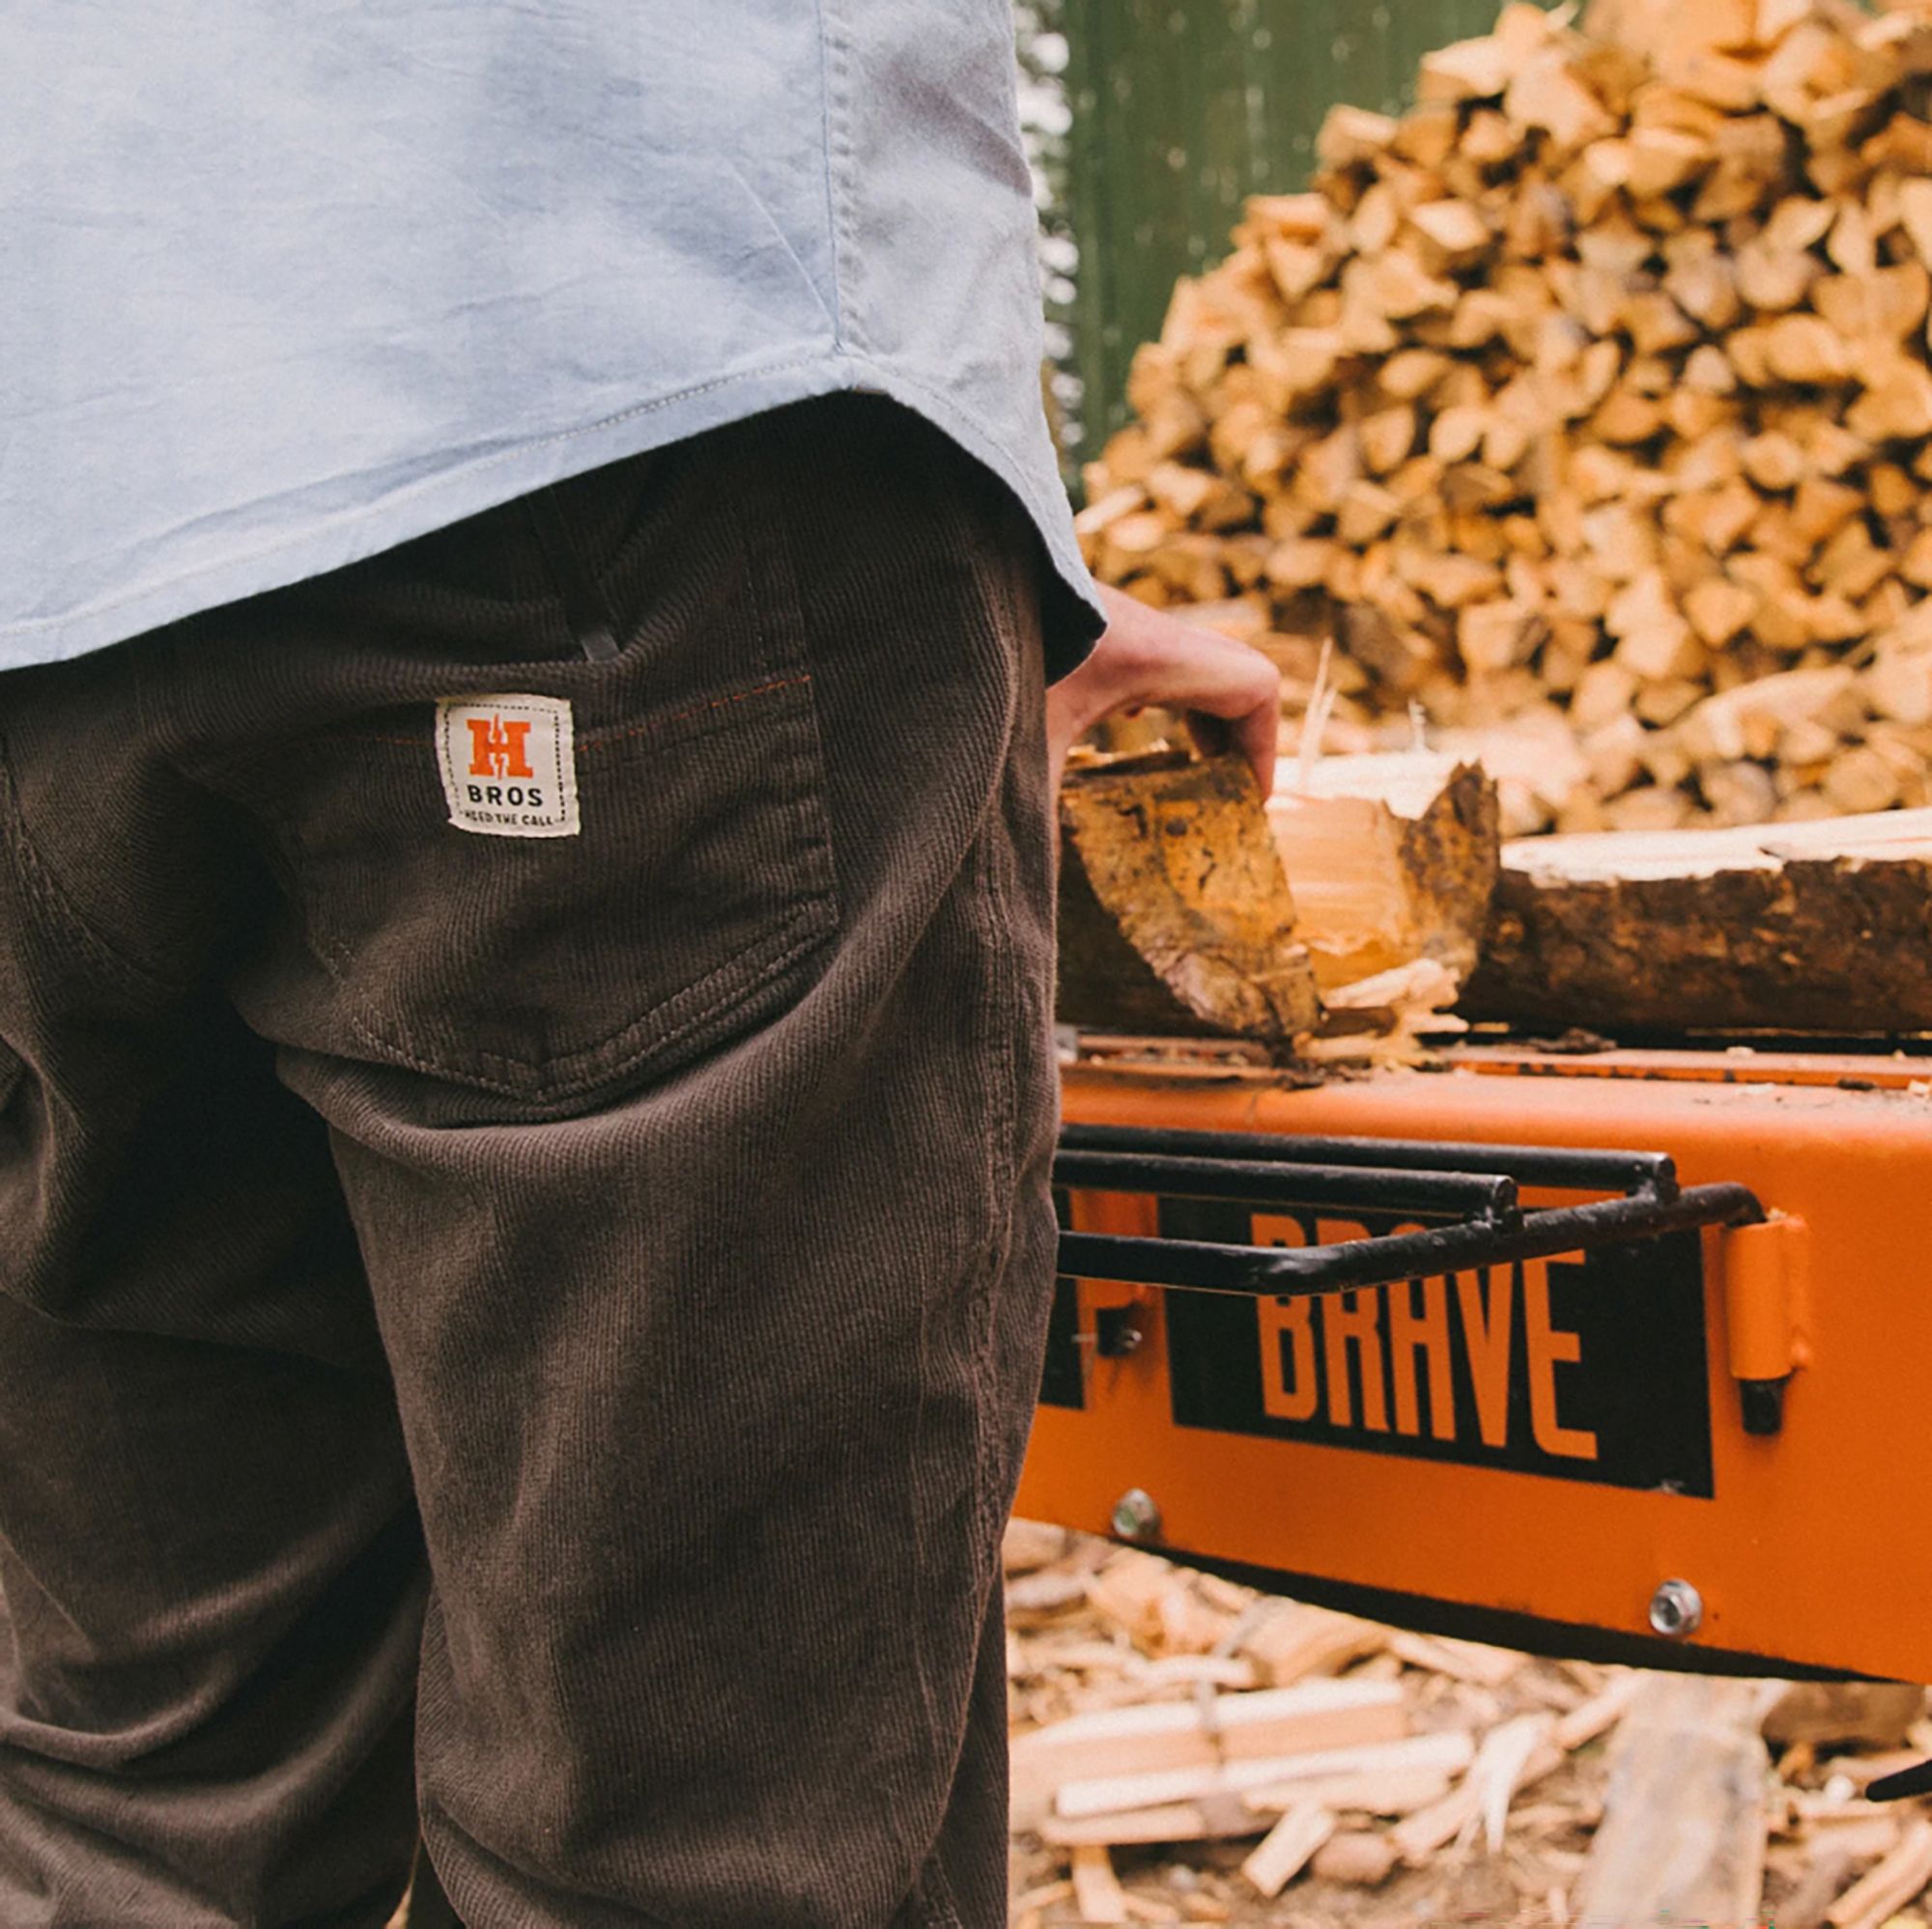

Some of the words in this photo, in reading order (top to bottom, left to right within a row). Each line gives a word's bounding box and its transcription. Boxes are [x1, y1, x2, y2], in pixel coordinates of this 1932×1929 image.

[467, 714, 534, 780] H
[467, 784, 543, 808] BROS
[495, 813, 518, 826] THE
[522, 814, 554, 827] CALL
[1251, 1213, 1599, 1461] BRAVE
